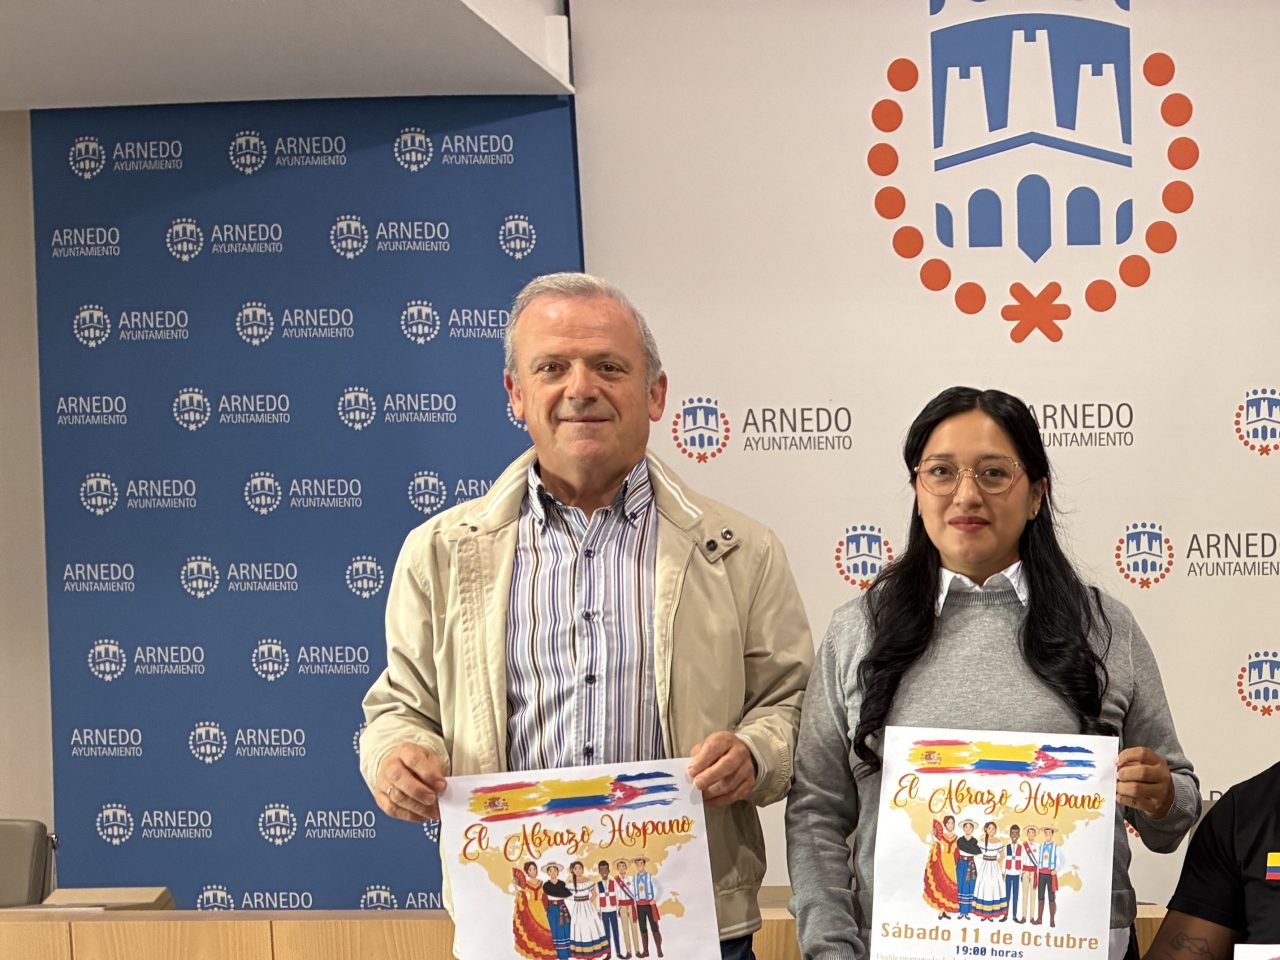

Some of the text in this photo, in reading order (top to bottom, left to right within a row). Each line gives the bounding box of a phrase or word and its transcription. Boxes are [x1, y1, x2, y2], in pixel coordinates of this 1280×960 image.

[113, 141, 182, 159] ARNEDO
[275, 136, 345, 154] ARNEDO
[441, 135, 513, 152] ARNEDO
[114, 160, 182, 170] AYUNTAMIENTO
[276, 155, 346, 166] AYUNTAMIENTO
[442, 154, 514, 164] AYUNTAMIENTO
[52, 228, 119, 245] ARNEDO
[211, 224, 282, 241] ARNEDO
[376, 222, 449, 239] ARNEDO
[53, 246, 120, 257] AYUNTAMIENTO
[212, 243, 282, 253] AYUNTAMIENTO
[377, 241, 450, 251] AYUNTAMIENTO
[119, 311, 188, 328] ARNEDO
[282, 309, 353, 326] ARNEDO
[448, 309, 510, 327] ARNED
[120, 329, 188, 340] AYUNTAMIENTO
[283, 328, 354, 337] AYUNTAMIENTO
[449, 328, 505, 339] AYUNTAMIE
[57, 396, 126, 413] ARNEDO
[219, 395, 289, 411] ARNEDO
[384, 394, 456, 411] ARNEDO
[58, 415, 127, 424] AYUNTAMIENTO
[220, 413, 290, 423] AYUNTAMIENTO
[385, 412, 456, 422] AYUNTAMIENTO
[743, 407, 851, 433] ARNEDO
[744, 436, 852, 451] AYUNTAMIENTO
[126, 480, 196, 496] ARNEDO
[290, 479, 361, 496] ARNEDO
[128, 498, 196, 508] AYUNTAMIENTO
[291, 498, 362, 507] AYUNTAMIENTO
[64, 564, 134, 580] ARNEDO
[227, 563, 297, 579] ARNEDO
[65, 582, 135, 591] AYUNTAMIENTO
[229, 581, 298, 591] AYUNTAMIENTO
[134, 647, 204, 663] ARNEDO
[297, 646, 368, 662] ARNEDO
[135, 665, 205, 674] AYUNTAMIENTO
[299, 665, 369, 674] AYUNTAMIENTO
[71, 729, 141, 745] ARNEDO
[235, 729, 305, 745] ARNEDO
[72, 747, 142, 756] AYUNTAMIENTO
[236, 747, 305, 756] AYUNTAMIENTO
[894, 774, 1104, 819] El Abrazo Hispano
[141, 811, 211, 827] ARNEDO
[305, 811, 375, 827] ARNEDO
[143, 829, 212, 838] AYUNTAMIENTO
[306, 829, 375, 838] AYUNTAMIENTO
[463, 814, 692, 862] El Abrazo Hispano
[241, 892, 313, 909] ARNEDO
[882, 923, 1098, 949] Sábado 11 de Octubre
[957, 946, 1023, 958] 19:00 horas
